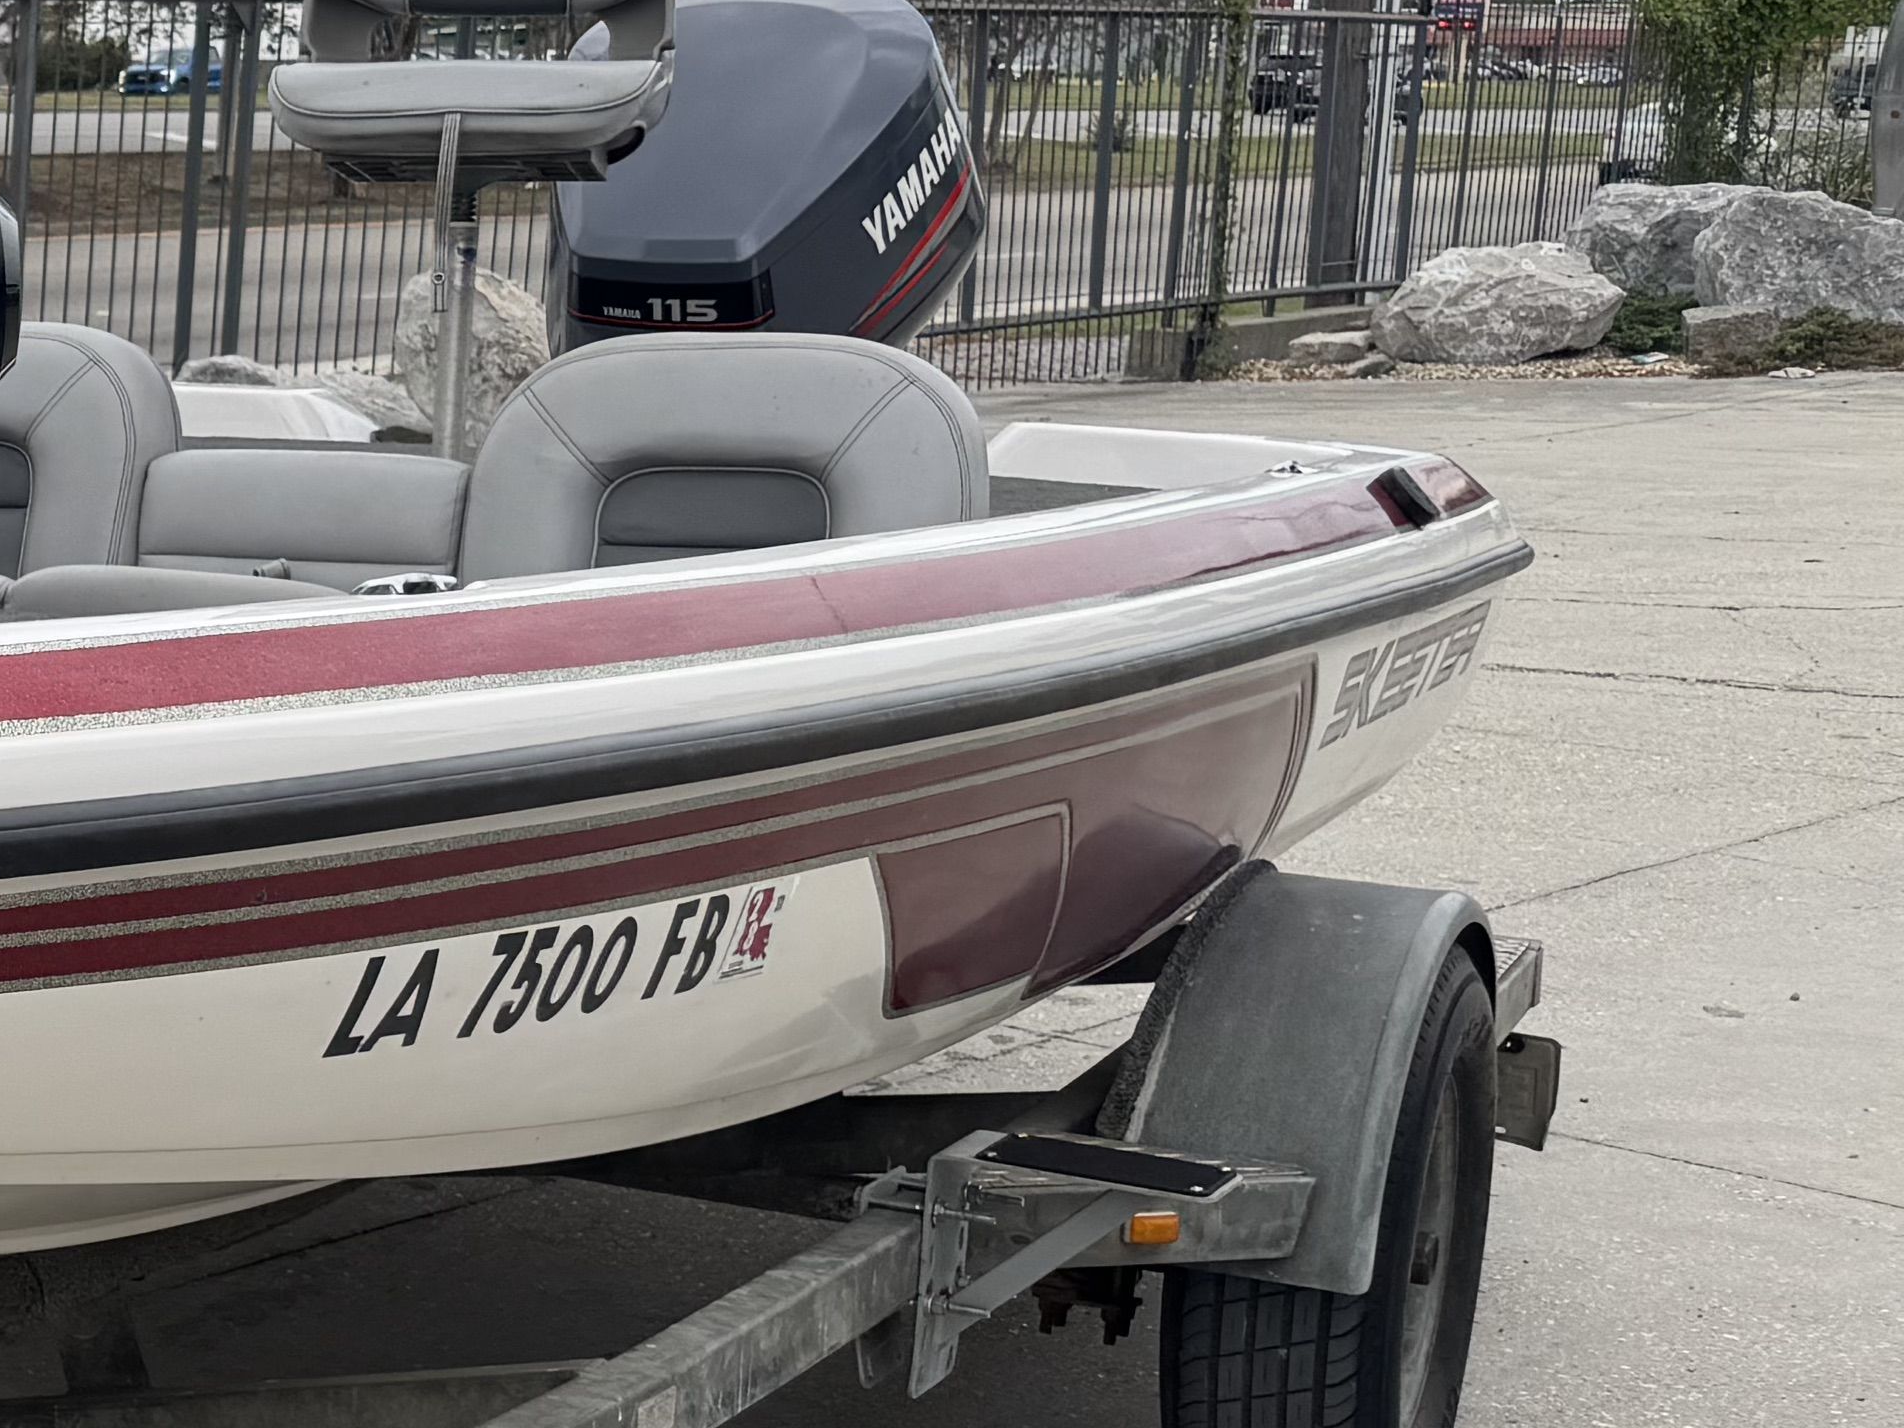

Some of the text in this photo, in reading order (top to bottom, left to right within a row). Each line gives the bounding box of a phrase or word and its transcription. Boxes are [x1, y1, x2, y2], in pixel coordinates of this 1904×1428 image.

[861, 107, 961, 255] YAMAHA
[602, 298, 719, 322] YAMAHA 115
[1318, 598, 1492, 751] SKEETER
[322, 893, 731, 1058] LA 7500 FB
